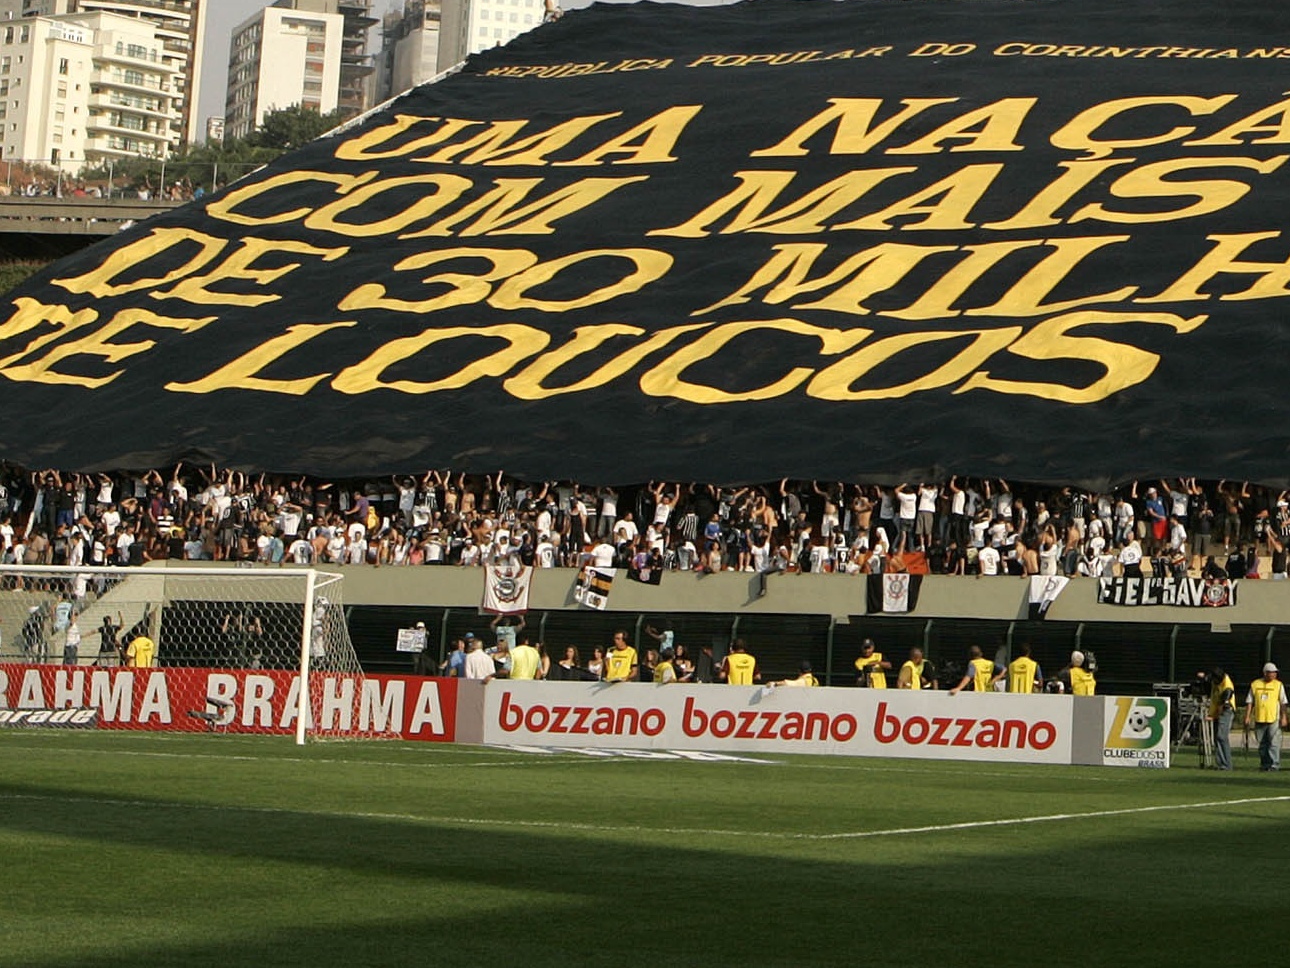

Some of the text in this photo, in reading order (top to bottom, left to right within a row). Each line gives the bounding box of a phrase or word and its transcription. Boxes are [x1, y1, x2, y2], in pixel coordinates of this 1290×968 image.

[477, 59, 674, 79] REPÚBLICA
[685, 46, 893, 68] POPULAR
[907, 43, 977, 57] DO
[335, 105, 703, 166] UMA
[206, 155, 1290, 239] COM MAIS
[50, 227, 350, 307] DE
[338, 247, 674, 314] 30
[0, 296, 1209, 403] DE LOUCOS
[206, 673, 445, 735] BRAHMA
[499, 692, 1056, 750] bozzano bozzano bozzano
